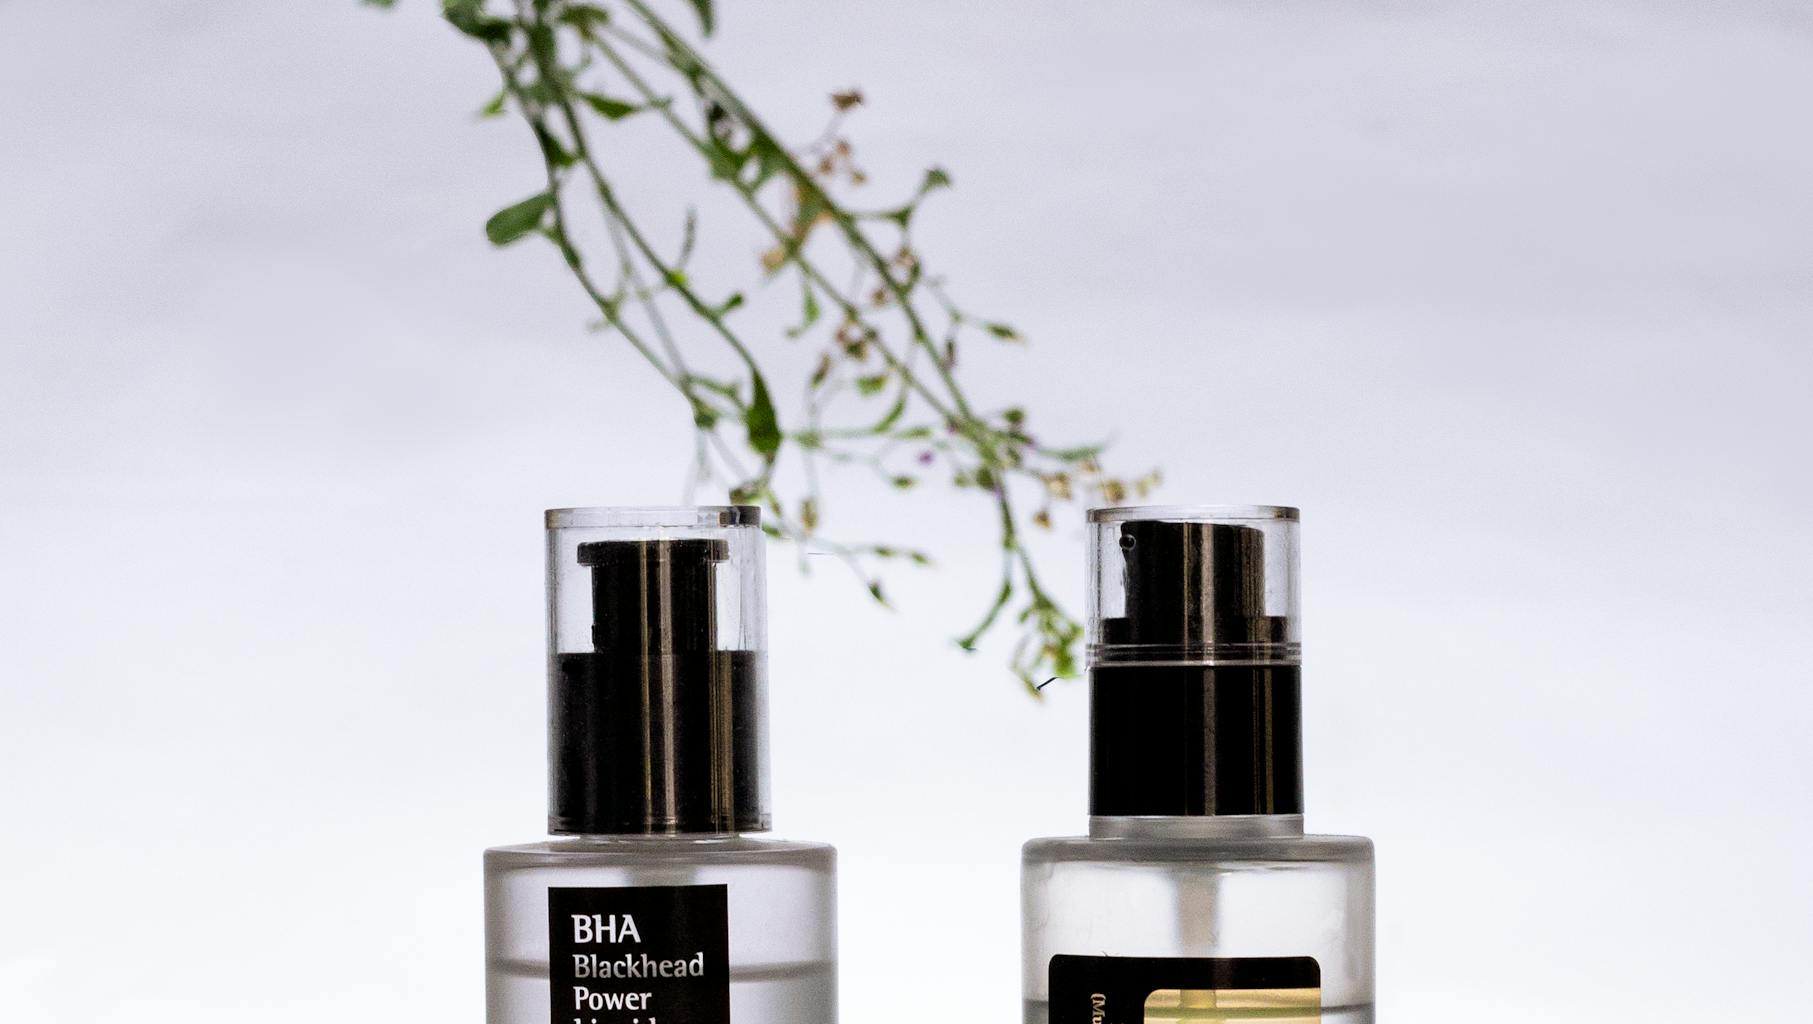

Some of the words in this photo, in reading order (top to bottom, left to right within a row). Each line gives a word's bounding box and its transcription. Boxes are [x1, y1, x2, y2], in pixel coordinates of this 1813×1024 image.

[571, 914, 642, 943] BHA
[572, 952, 704, 978] Blackhead
[573, 986, 652, 1010] Power
